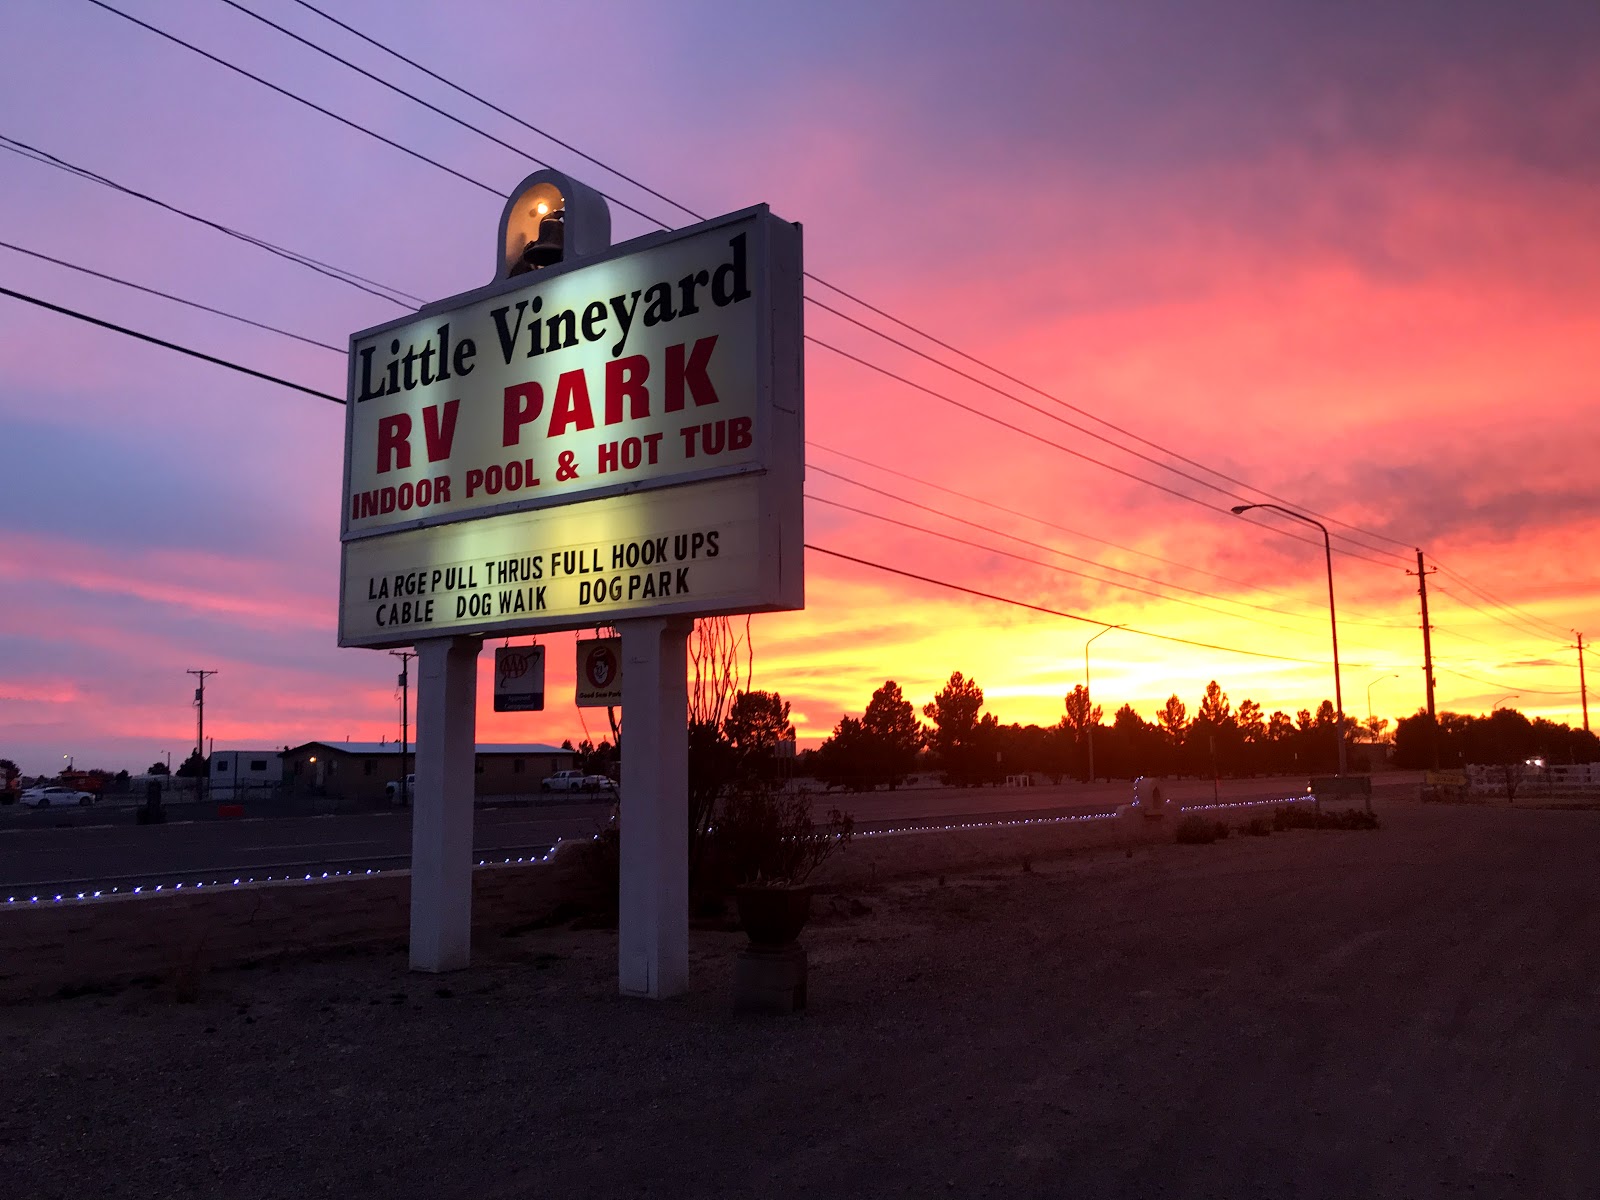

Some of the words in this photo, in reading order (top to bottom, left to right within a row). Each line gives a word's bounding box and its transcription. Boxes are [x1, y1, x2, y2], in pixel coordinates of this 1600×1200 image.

[357, 323, 477, 402] Little
[490, 233, 751, 364] Vineyard
[377, 400, 460, 474] RV
[502, 335, 720, 447] PARK
[352, 475, 451, 520] INDOOR
[466, 458, 540, 498] POOL
[556, 451, 579, 481] &
[598, 433, 663, 474] HOT
[680, 416, 753, 459] TUB
[368, 570, 427, 600] LARGE
[431, 563, 478, 592] PULL
[486, 556, 543, 583] THRUS
[551, 549, 603, 577] FULL
[612, 537, 669, 569] HOOK
[674, 531, 720, 560] UPS
[376, 599, 434, 627] CABLE
[456, 593, 492, 619] DOG
[579, 576, 622, 606] DOG
[628, 567, 690, 600] PARK
